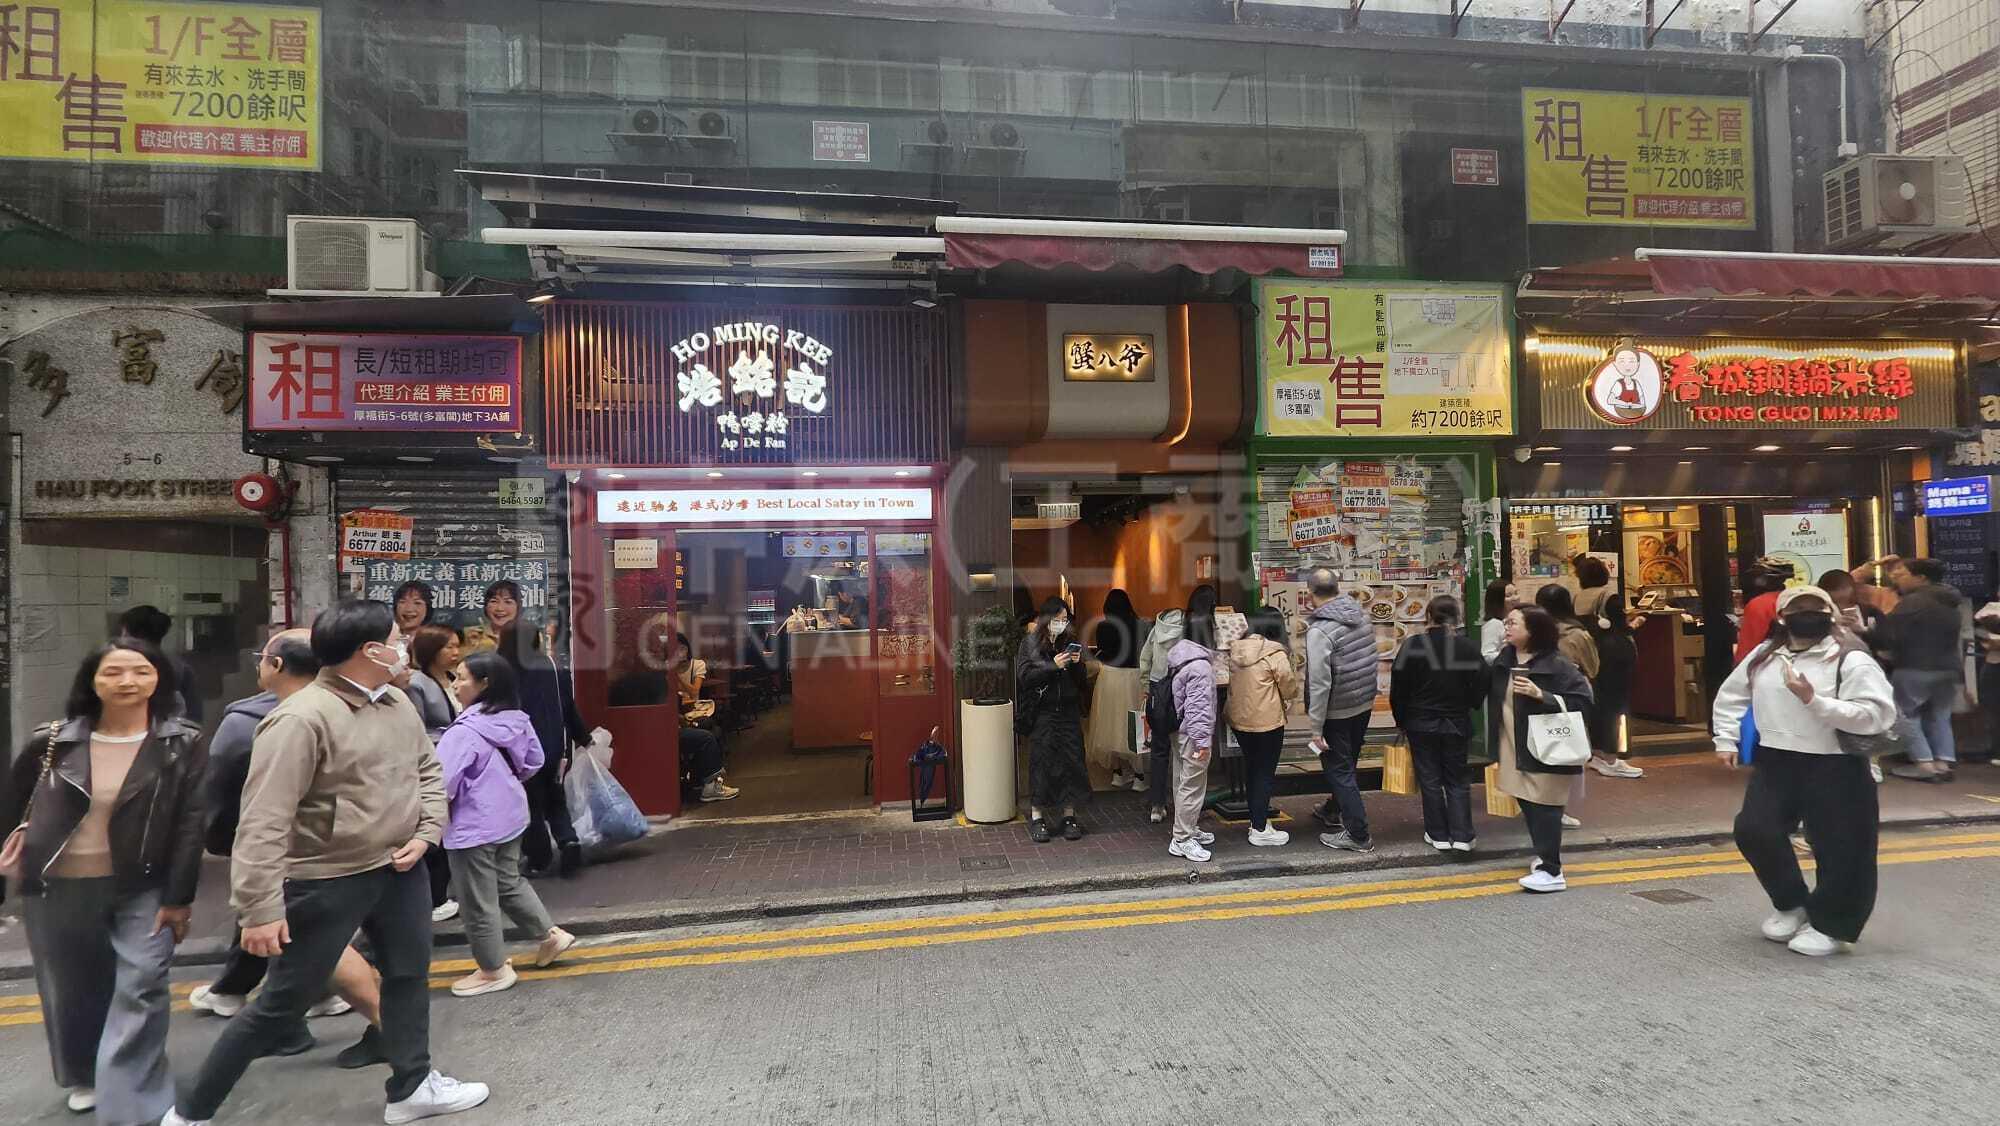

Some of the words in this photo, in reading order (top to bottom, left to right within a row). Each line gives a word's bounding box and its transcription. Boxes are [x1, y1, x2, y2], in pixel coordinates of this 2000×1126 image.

[0, 4, 65, 82] 租
[144, 15, 308, 64] 1/F全層
[54, 72, 128, 154] 售
[169, 90, 308, 123] 7200餘呎
[1534, 98, 1586, 162] 租
[1636, 105, 1742, 143] 1/F全層
[140, 129, 236, 152] 歡迎代理介紹
[239, 133, 301, 153] 業主付佣
[1580, 153, 1629, 218] 售
[1654, 167, 1744, 192] 7200餘呎
[1275, 294, 1336, 367] 租
[670, 332, 710, 364] HO
[713, 322, 780, 346] MING
[784, 329, 834, 367] KEE
[354, 347, 509, 376] 長/短租期均可
[268, 342, 344, 421] 租
[1328, 355, 1385, 429] 售
[360, 383, 430, 402] 代理介紹
[435, 384, 504, 403] 業主付佣
[1411, 409, 1503, 428] 約7200餘呎
[1690, 406, 1756, 422] TONG
[1764, 406, 1814, 422] GUO
[1820, 406, 1899, 421] MIXIAN
[721, 437, 739, 450] Ap
[743, 437, 760, 449] De
[35, 479, 84, 498] HAU
[90, 479, 156, 498] FOOK
[160, 479, 235, 497] STREE
[1927, 486, 1971, 498] Mama
[523, 496, 544, 504] 5987
[757, 498, 784, 509] Best
[788, 497, 821, 509] Local
[825, 496, 861, 512] Satay
[864, 496, 876, 508] in
[879, 496, 915, 508] Town
[1344, 497, 1365, 507] 6677
[1366, 497, 1386, 507] 8804
[352, 529, 377, 537] Arthur
[1295, 528, 1315, 541] 6677
[1317, 525, 1337, 537] 8804
[348, 539, 377, 551] 6677
[380, 540, 406, 553] 8804
[368, 562, 456, 581] 重新定義
[459, 562, 544, 581] 重新定義
